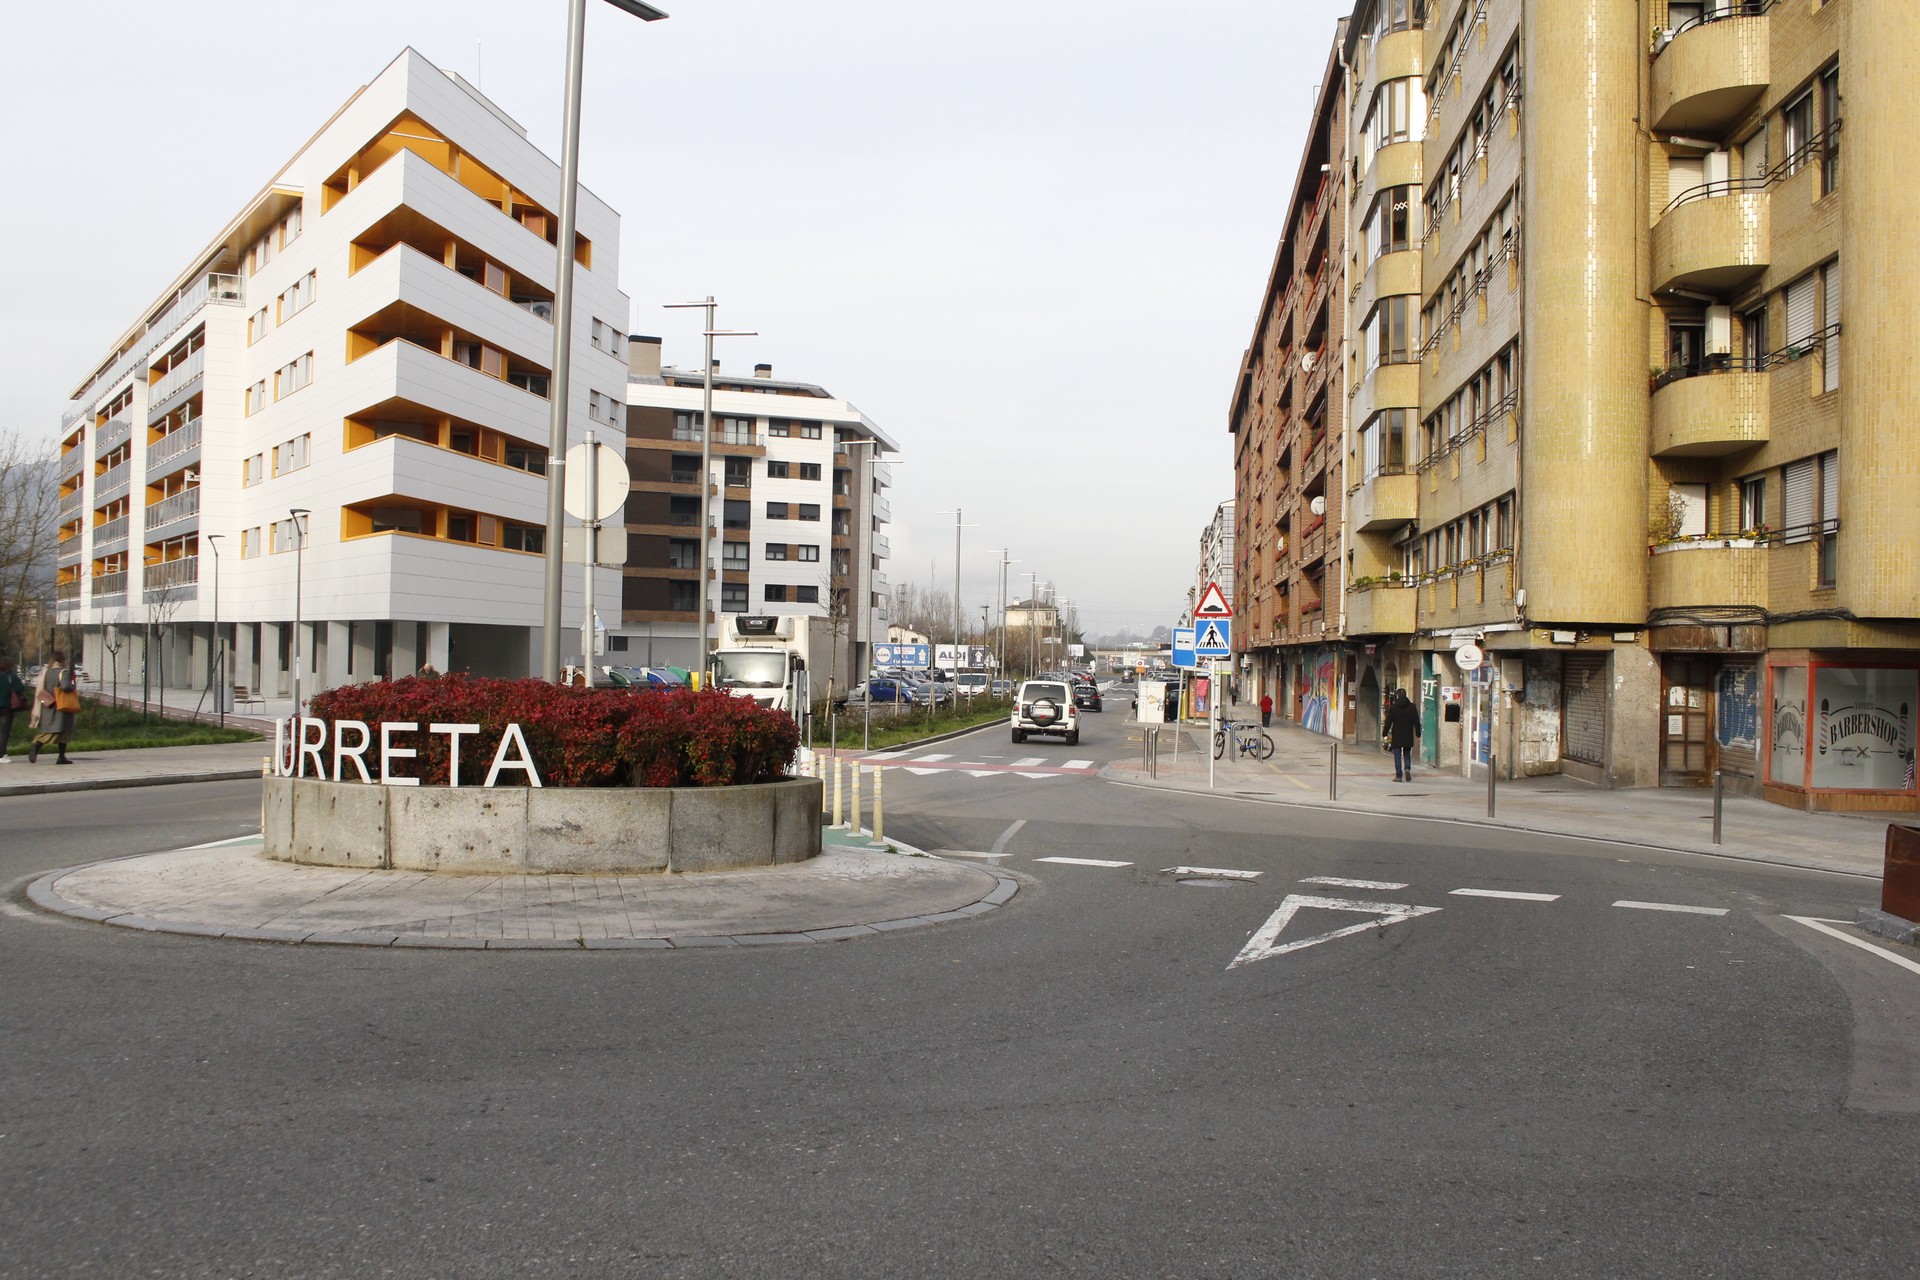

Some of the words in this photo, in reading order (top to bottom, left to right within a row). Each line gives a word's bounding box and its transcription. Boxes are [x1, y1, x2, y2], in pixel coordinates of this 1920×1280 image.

[939, 651, 966, 660] ALDI
[1830, 713, 1898, 746] BARBERSHOP
[274, 717, 543, 788] IURRETA
